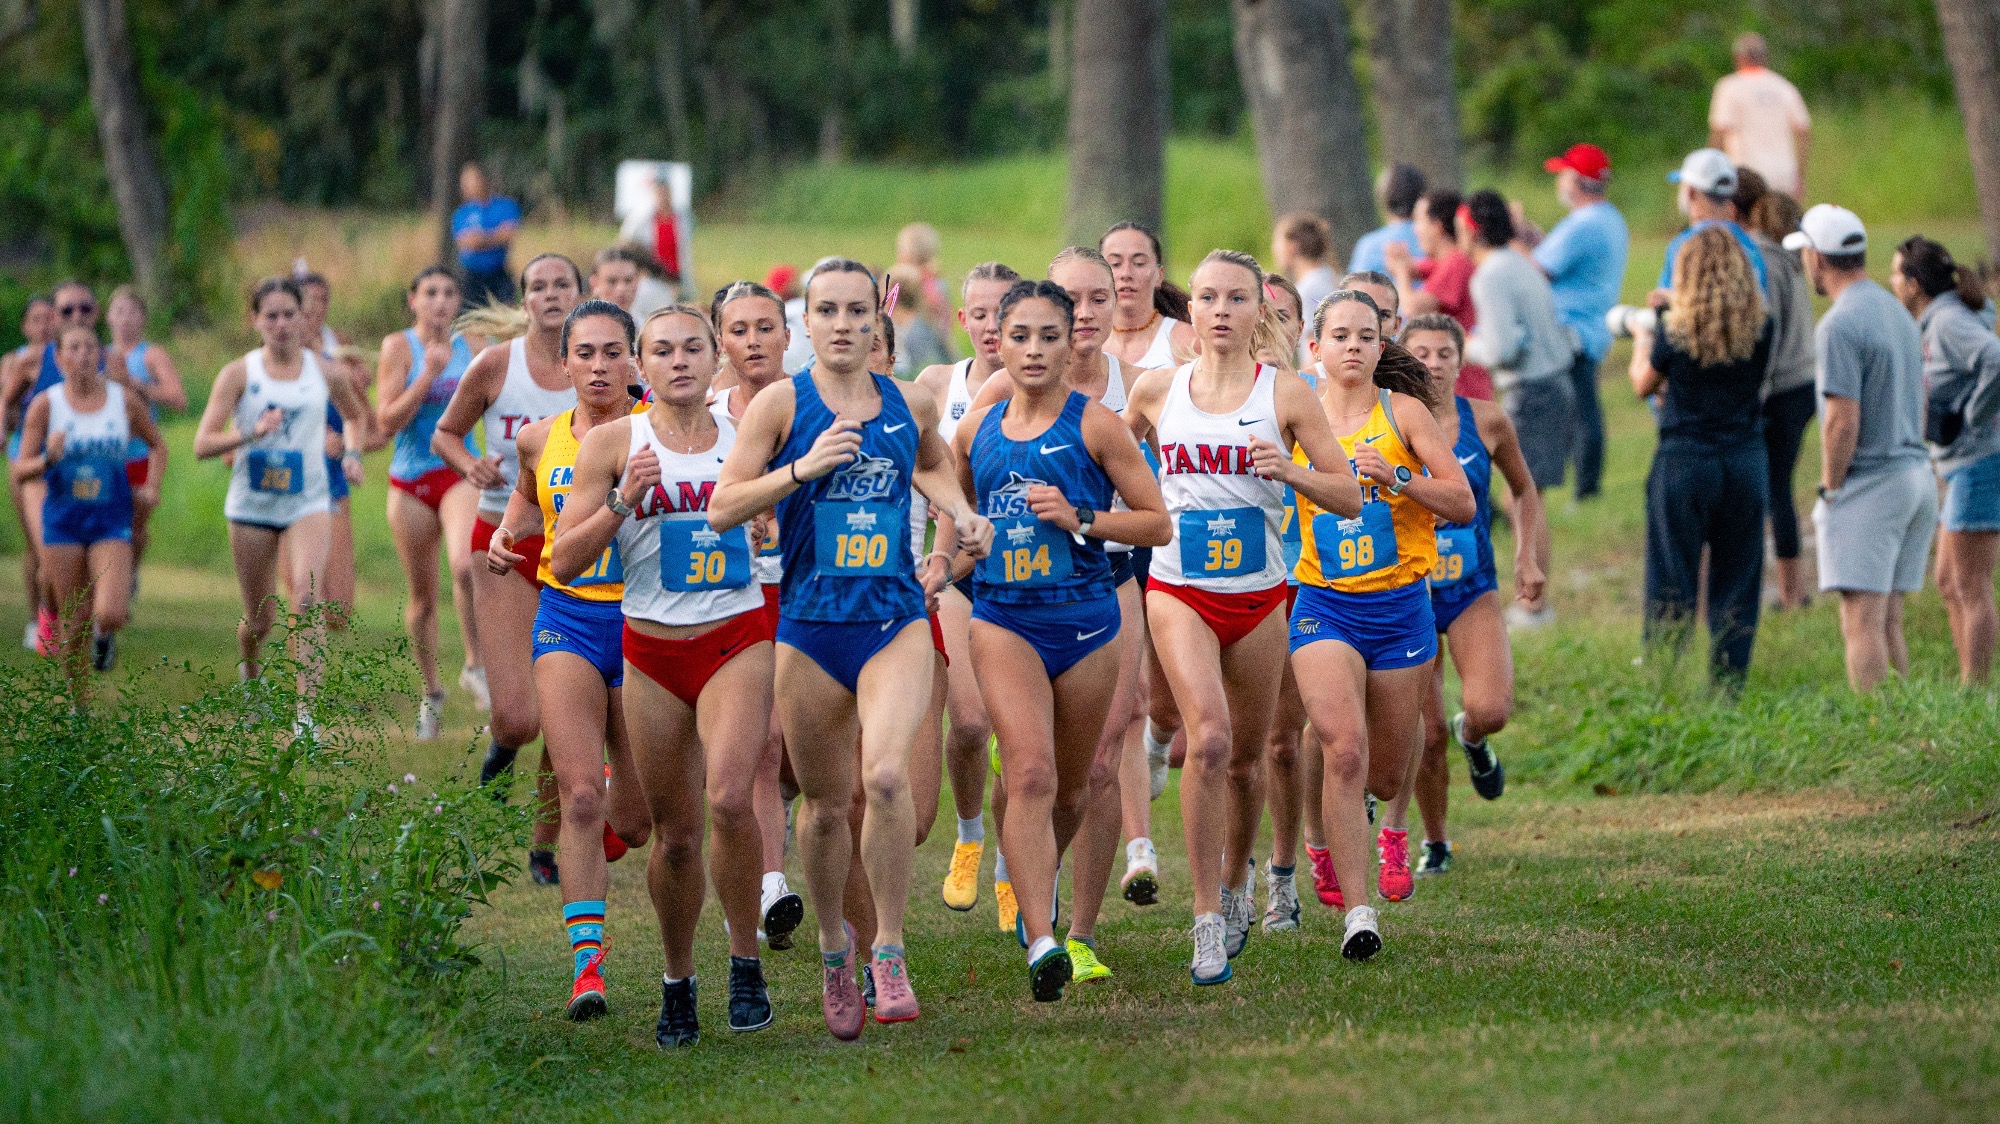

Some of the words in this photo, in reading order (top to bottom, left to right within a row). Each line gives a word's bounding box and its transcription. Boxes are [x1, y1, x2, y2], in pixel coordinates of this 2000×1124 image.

[829, 471, 896, 499] NSU
[989, 493, 1036, 518] NS
[835, 534, 888, 567] 190
[1002, 545, 1052, 582] 184
[1204, 538, 1243, 571] 39
[1338, 535, 1374, 570] 98
[685, 551, 726, 584] 30
[1431, 553, 1463, 582] 89
